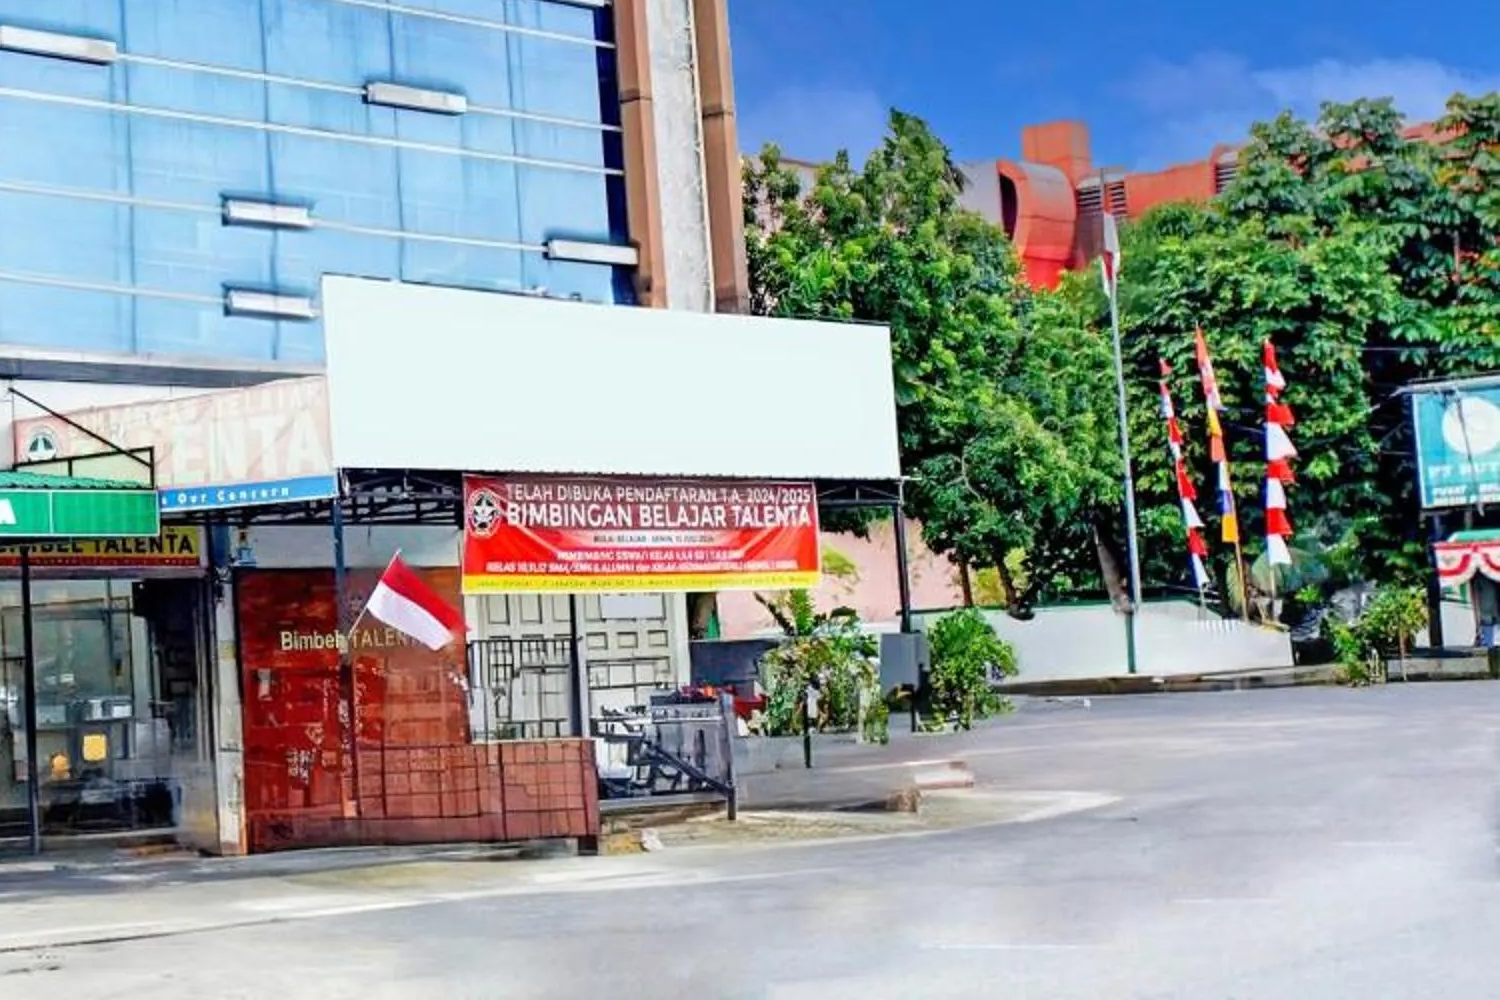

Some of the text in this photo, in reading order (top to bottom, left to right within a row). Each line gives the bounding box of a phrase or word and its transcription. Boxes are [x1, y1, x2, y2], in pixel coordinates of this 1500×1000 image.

[177, 492, 207, 505] Our
[506, 483, 552, 501] TELAH
[558, 485, 612, 502] DIBUKA
[617, 486, 716, 504] PENDAFTARAN
[508, 503, 812, 528] BIMBINGAN BELAJAR TALENTA
[92, 533, 194, 555] TALENTA
[352, 627, 419, 649] TALEN
